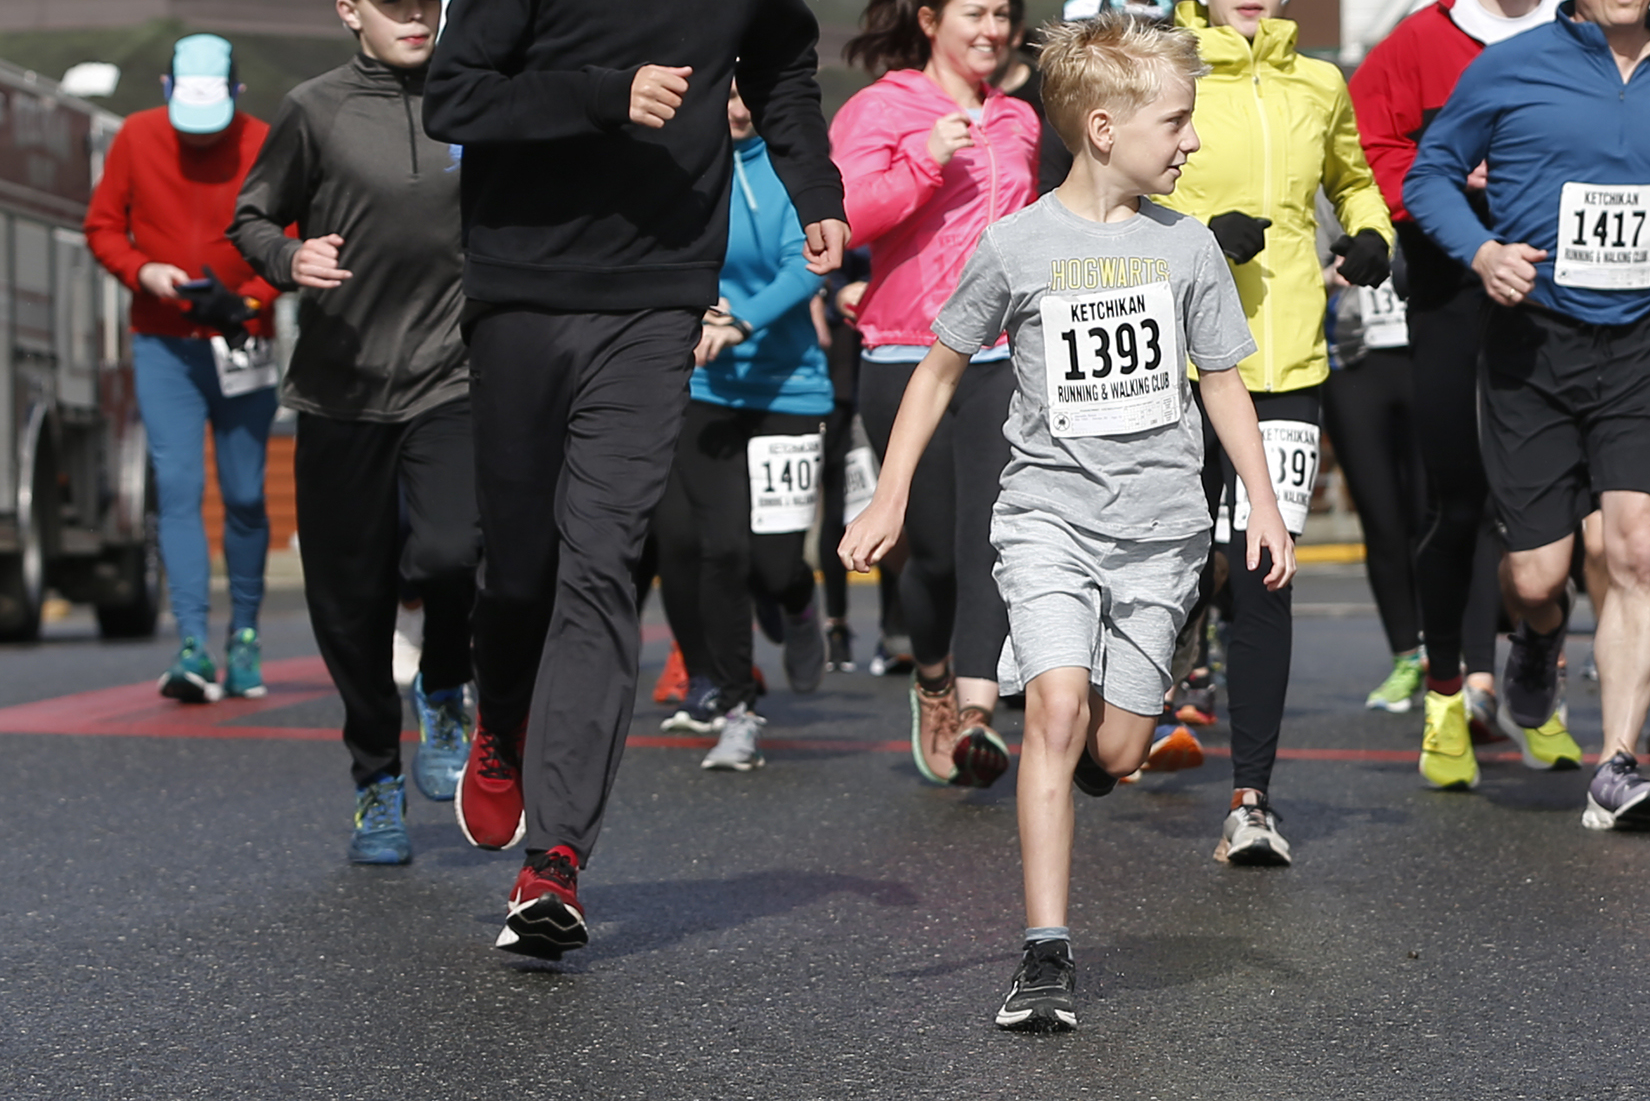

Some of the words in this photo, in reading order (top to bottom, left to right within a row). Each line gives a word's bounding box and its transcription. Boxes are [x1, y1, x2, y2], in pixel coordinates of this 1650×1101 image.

[1585, 192, 1639, 206] KETCHIKAN
[1572, 209, 1646, 248] 1417
[1051, 257, 1169, 291] HOGWARTS
[1071, 294, 1146, 322] KETCHIKAN
[1061, 318, 1162, 380] 1393
[1058, 384, 1099, 403] RUNNING
[1101, 383, 1108, 400] &
[1110, 377, 1149, 399] WALKING
[1151, 372, 1170, 392] CLUB
[1261, 428, 1315, 446] KETCHIKAN
